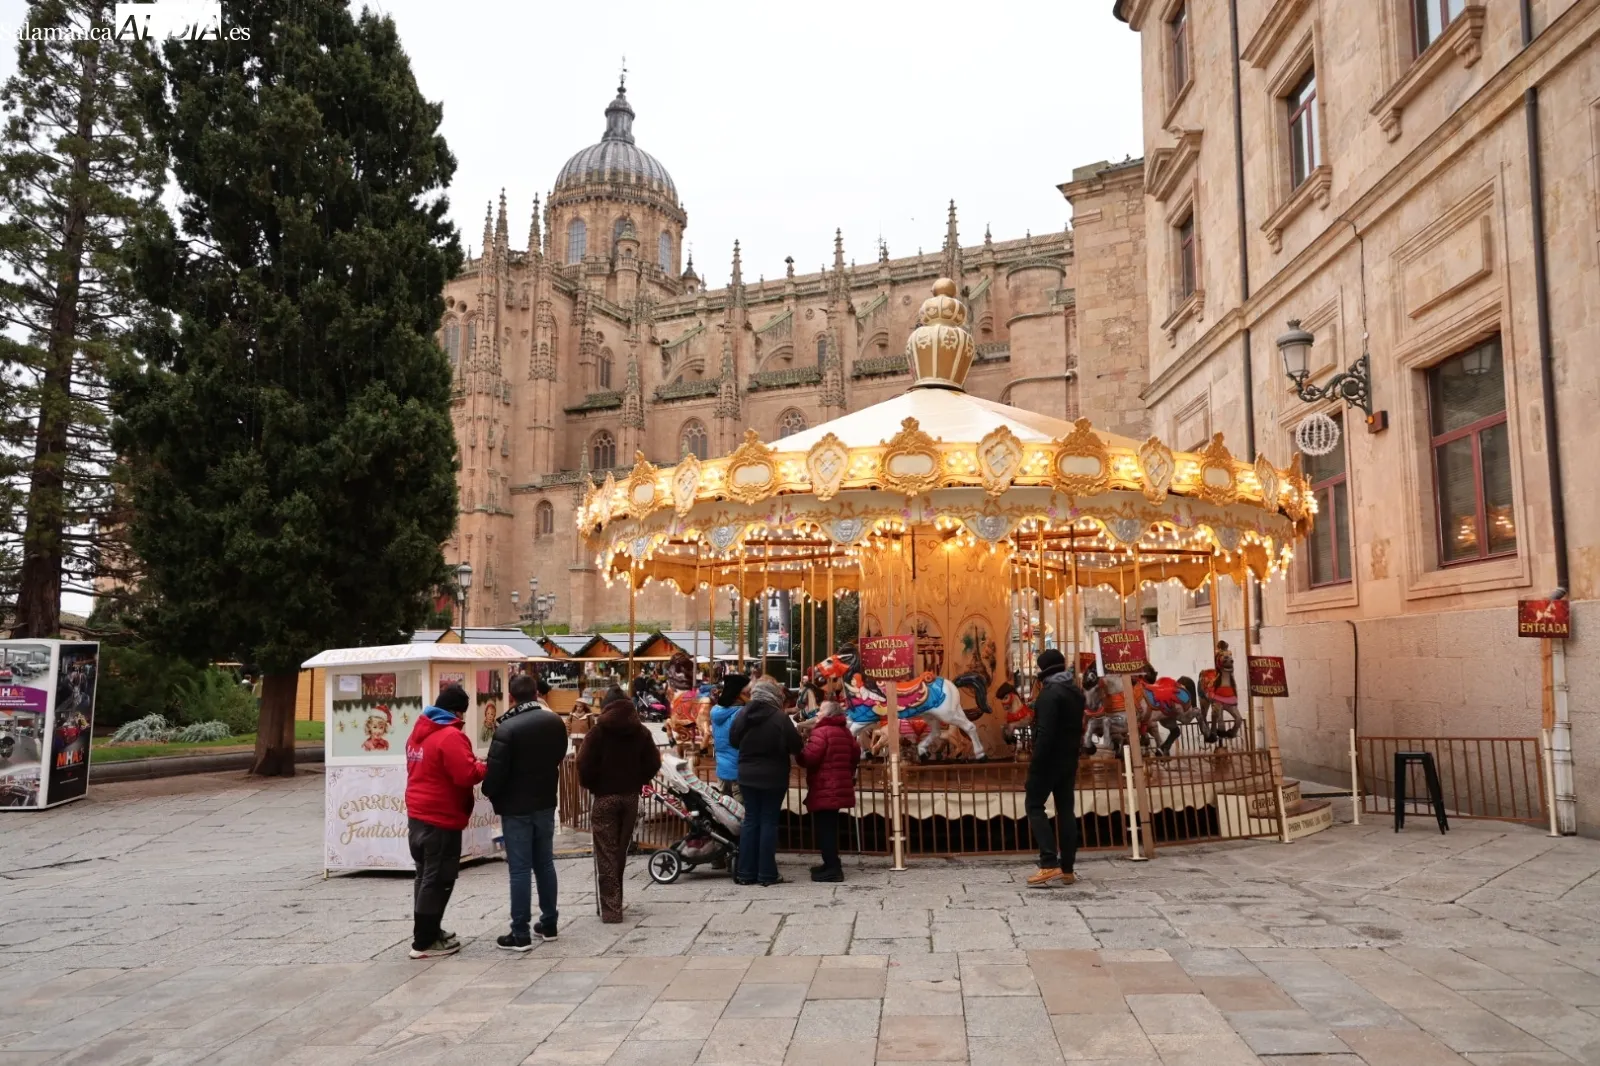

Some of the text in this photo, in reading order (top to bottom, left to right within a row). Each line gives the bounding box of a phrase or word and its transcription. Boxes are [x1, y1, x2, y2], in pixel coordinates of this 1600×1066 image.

[1520, 622, 1568, 634] ENTRADA
[865, 638, 909, 649] ENTRADA
[1103, 633, 1140, 644] ENTRADA
[1104, 661, 1145, 672] CARRUSEL
[1249, 659, 1281, 668] ENTRADA
[864, 667, 911, 678] CARRUSEL
[0, 688, 19, 696] HA
[1251, 684, 1286, 694] CARRUSEL
[56, 750, 79, 767] MHA
[338, 794, 407, 820] CARRUSE
